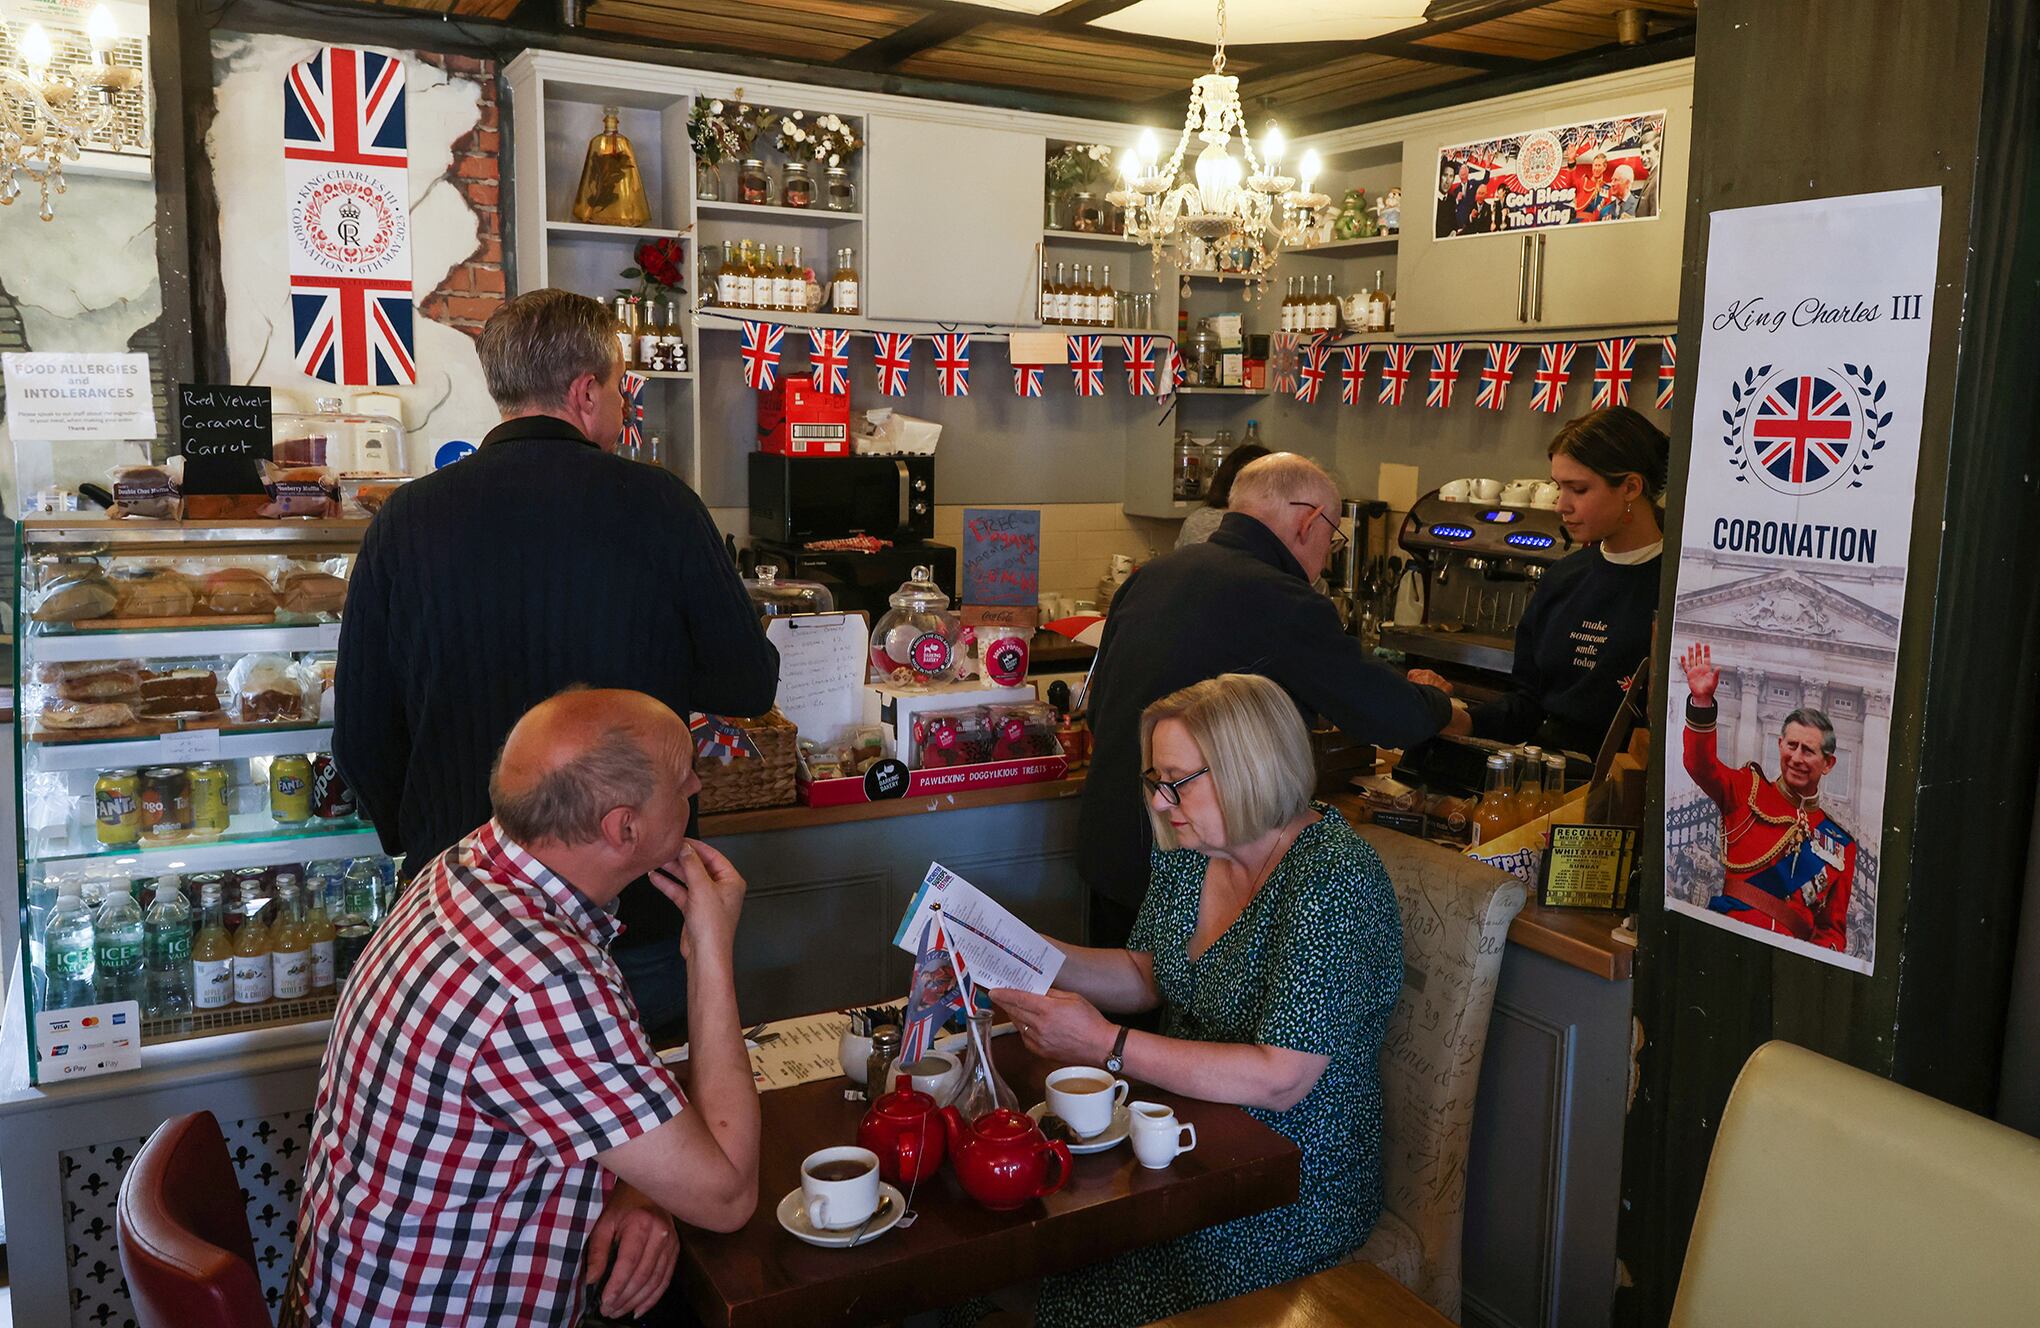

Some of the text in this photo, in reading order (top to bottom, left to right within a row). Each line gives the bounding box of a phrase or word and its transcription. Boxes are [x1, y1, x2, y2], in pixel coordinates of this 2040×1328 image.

[299, 170, 398, 205] KING CHARLES III
[1506, 186, 1577, 208] God Bless
[1508, 205, 1571, 227] The King
[292, 208, 344, 272] CORONATION
[359, 214, 406, 274] 6TH MAY 2023
[1712, 294, 1923, 333] King Charles III
[15, 364, 138, 374] FOOD ALLERGIES
[68, 377, 90, 385] and
[24, 388, 134, 399] INTOLERANCES
[184, 391, 270, 407] Red Velvet
[182, 415, 265, 429] Caramel
[185, 438, 252, 455] Carrot
[1713, 517, 1877, 564] CORONATION
[1582, 620, 1608, 631] make
[1569, 631, 1608, 643] someone
[1575, 645, 1598, 655] smile
[1573, 657, 1597, 670] today
[920, 765, 1047, 787] PAWLICKING DOGGYLICIOUS TREATS
[143, 801, 164, 813] ngo
[1557, 829, 1620, 837] RECOLLECT
[1555, 849, 1616, 857] WHITSTABLE
[57, 951, 88, 965] ICE
[101, 947, 130, 960] ICE
[101, 959, 130, 967] VALLEY
